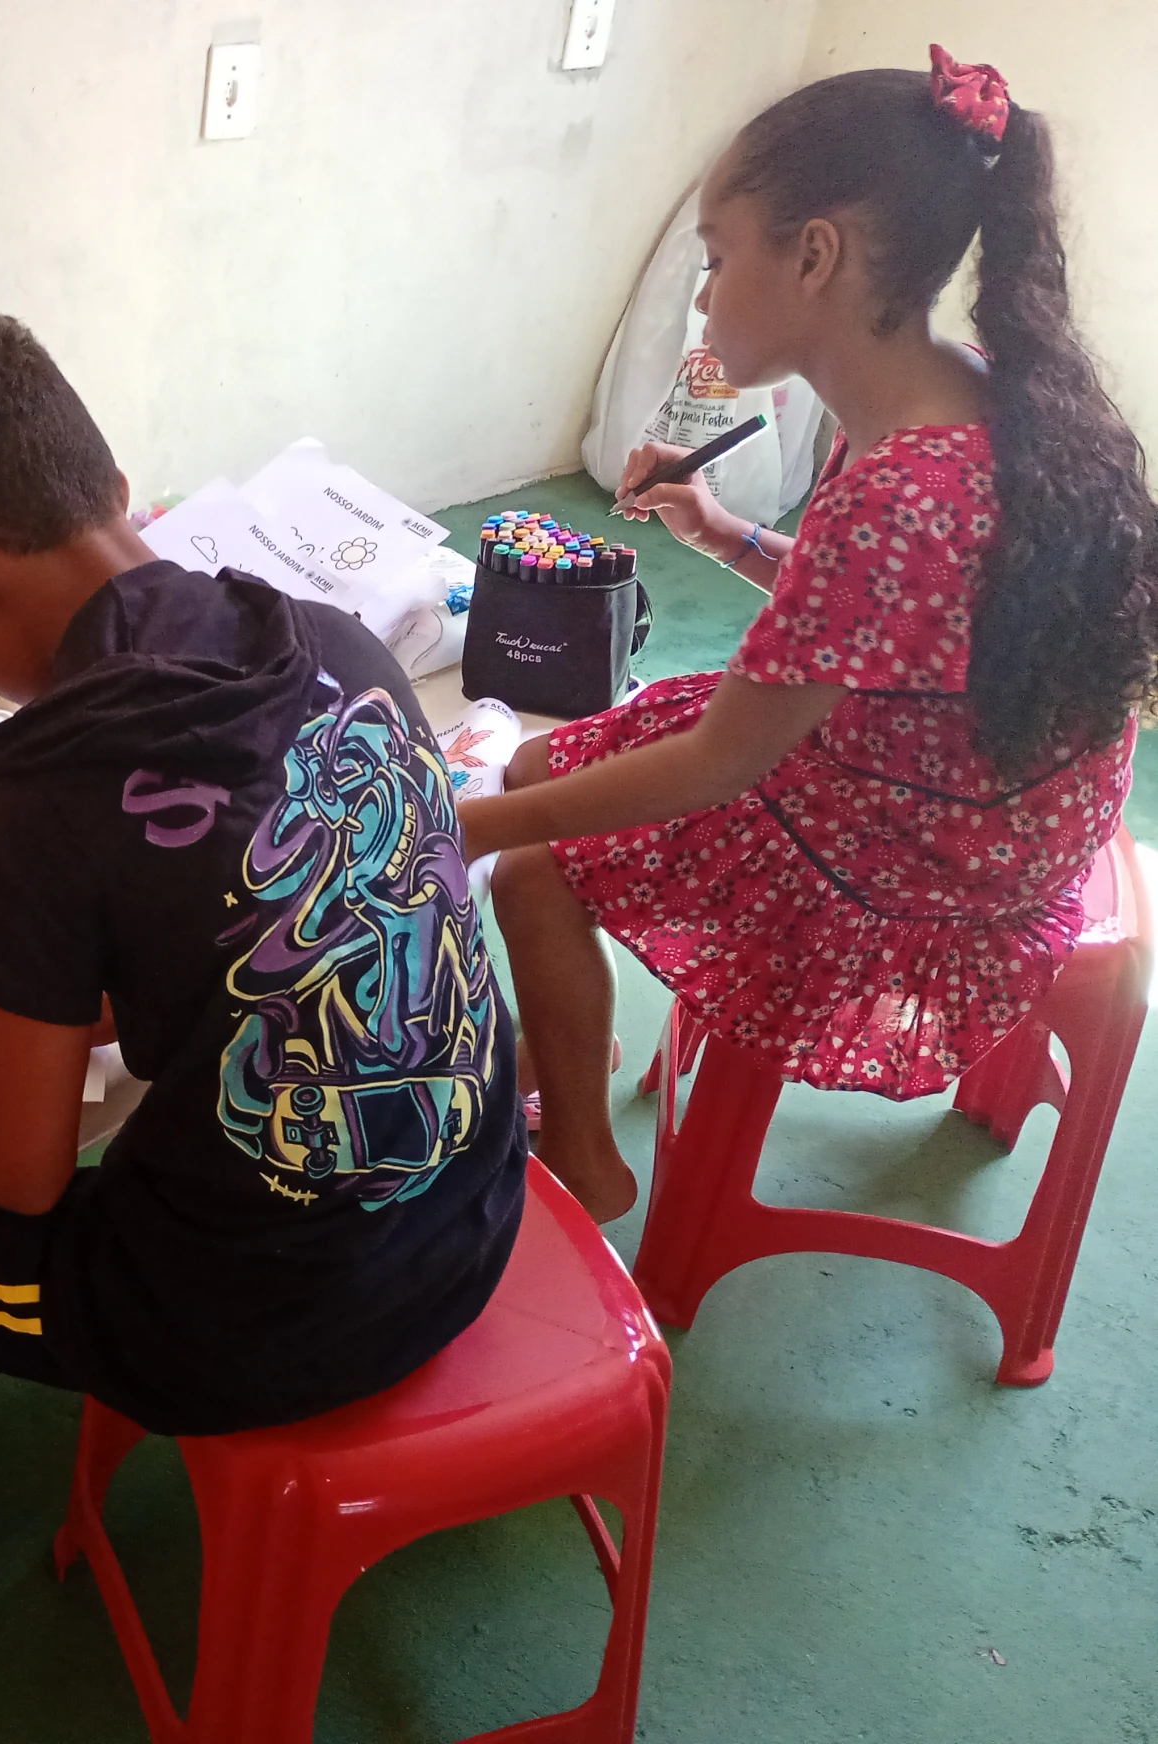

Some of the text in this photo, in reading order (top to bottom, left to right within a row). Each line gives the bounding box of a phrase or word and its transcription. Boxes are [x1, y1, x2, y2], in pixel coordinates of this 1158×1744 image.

[702, 411, 734, 428] Festas
[323, 486, 385, 531] NOSSO JARDIM
[248, 524, 305, 574] NOSSO JARDIM
[506, 649, 542, 663] 48pcs
[436, 721, 464, 738] RDIM
